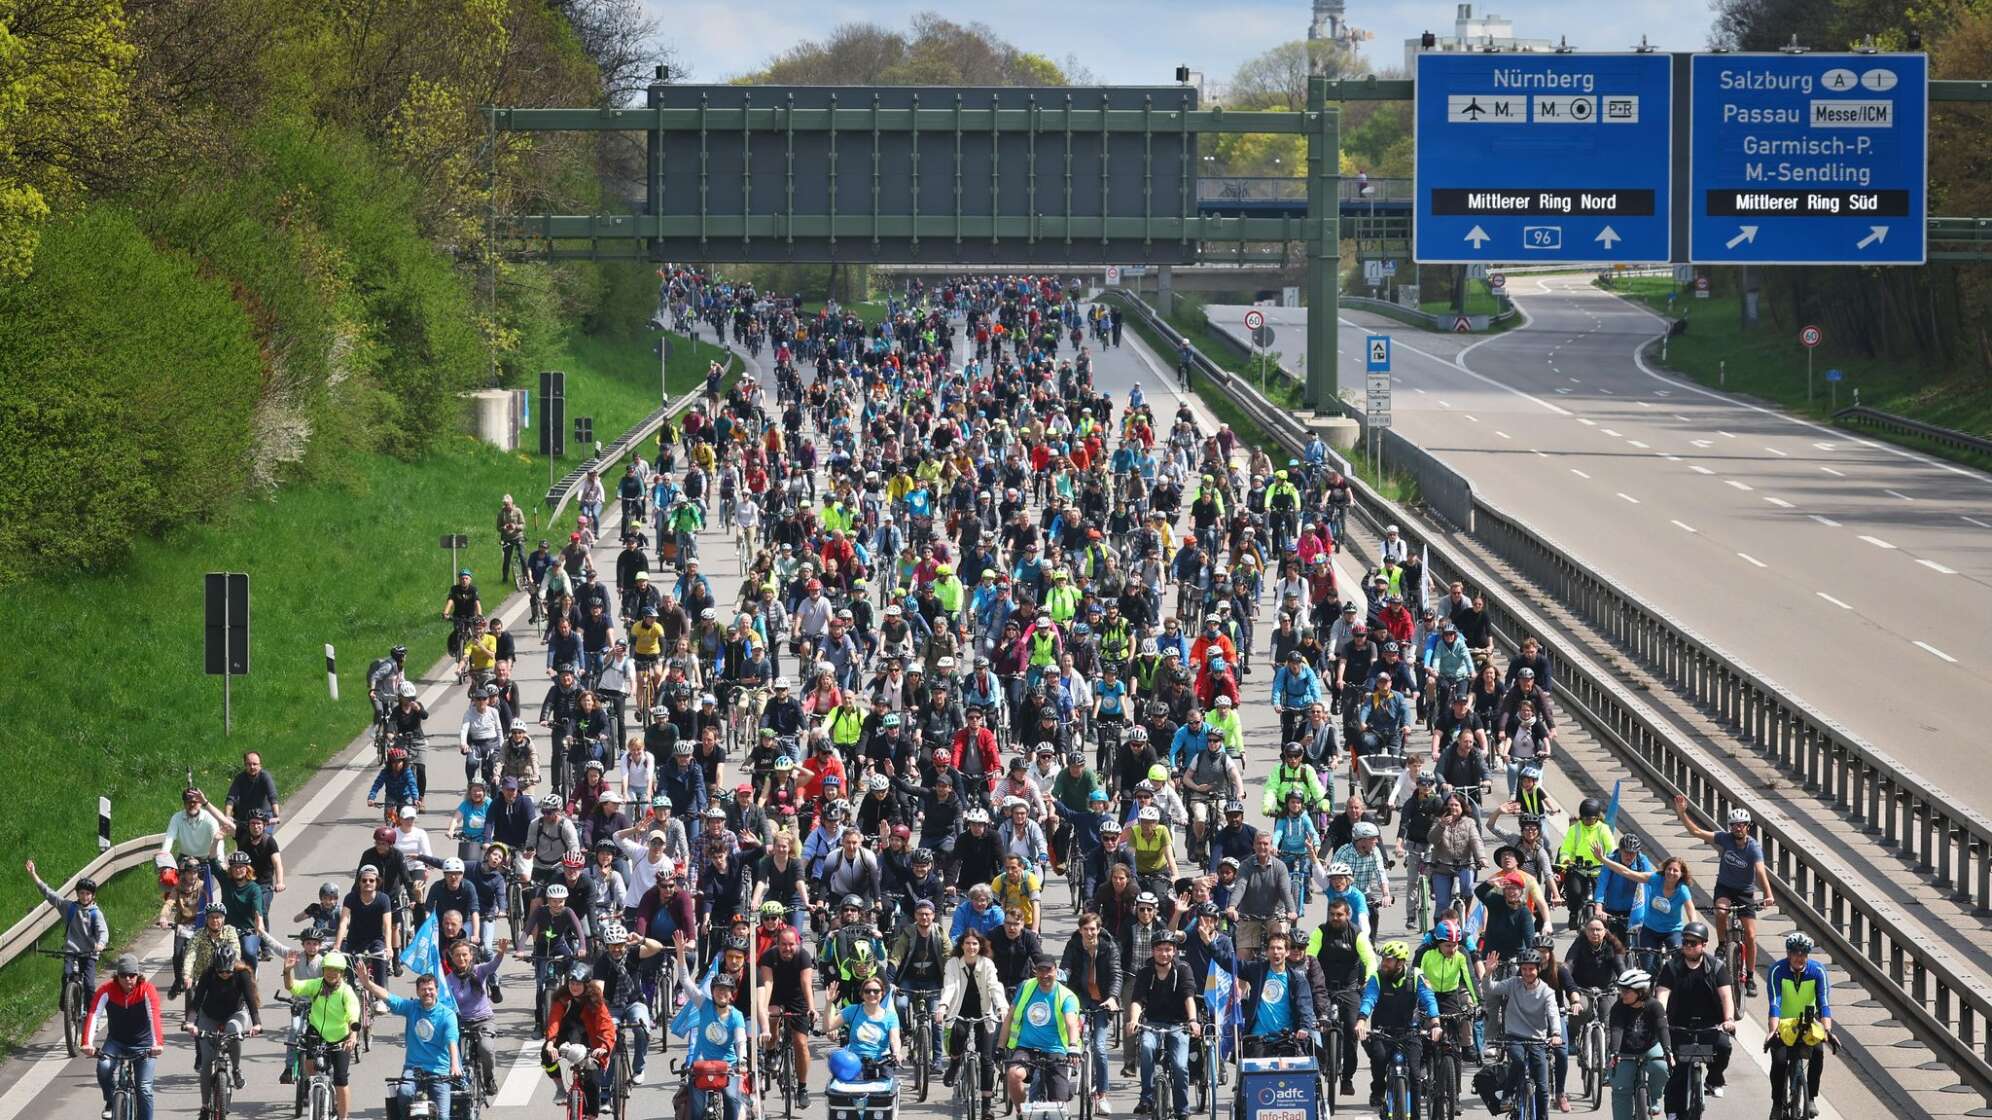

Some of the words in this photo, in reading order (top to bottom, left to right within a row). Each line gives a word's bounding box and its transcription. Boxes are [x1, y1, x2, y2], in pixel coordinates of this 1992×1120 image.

[1493, 69, 1594, 92] Nürnberg
[1720, 70, 1813, 94] Salzburg
[1833, 73, 1845, 87] A
[1495, 101, 1514, 117] M.
[1541, 101, 1560, 117] M.
[1723, 104, 1800, 123] Passau
[1816, 105, 1887, 121] Messe/ICM
[1743, 136, 1873, 155] Garmisch-P.
[1745, 162, 1871, 186] M.-Sendling
[1468, 193, 1530, 209] Mittlerer
[1539, 193, 1572, 213] Ring
[1581, 193, 1617, 209] Nord
[1735, 194, 1799, 210] Mittlerer
[1807, 194, 1840, 213] Ring
[1849, 193, 1878, 210] Süd
[1534, 231, 1552, 245] 96
[1248, 315, 1260, 325] 60
[1276, 1087, 1304, 1099] adfc
